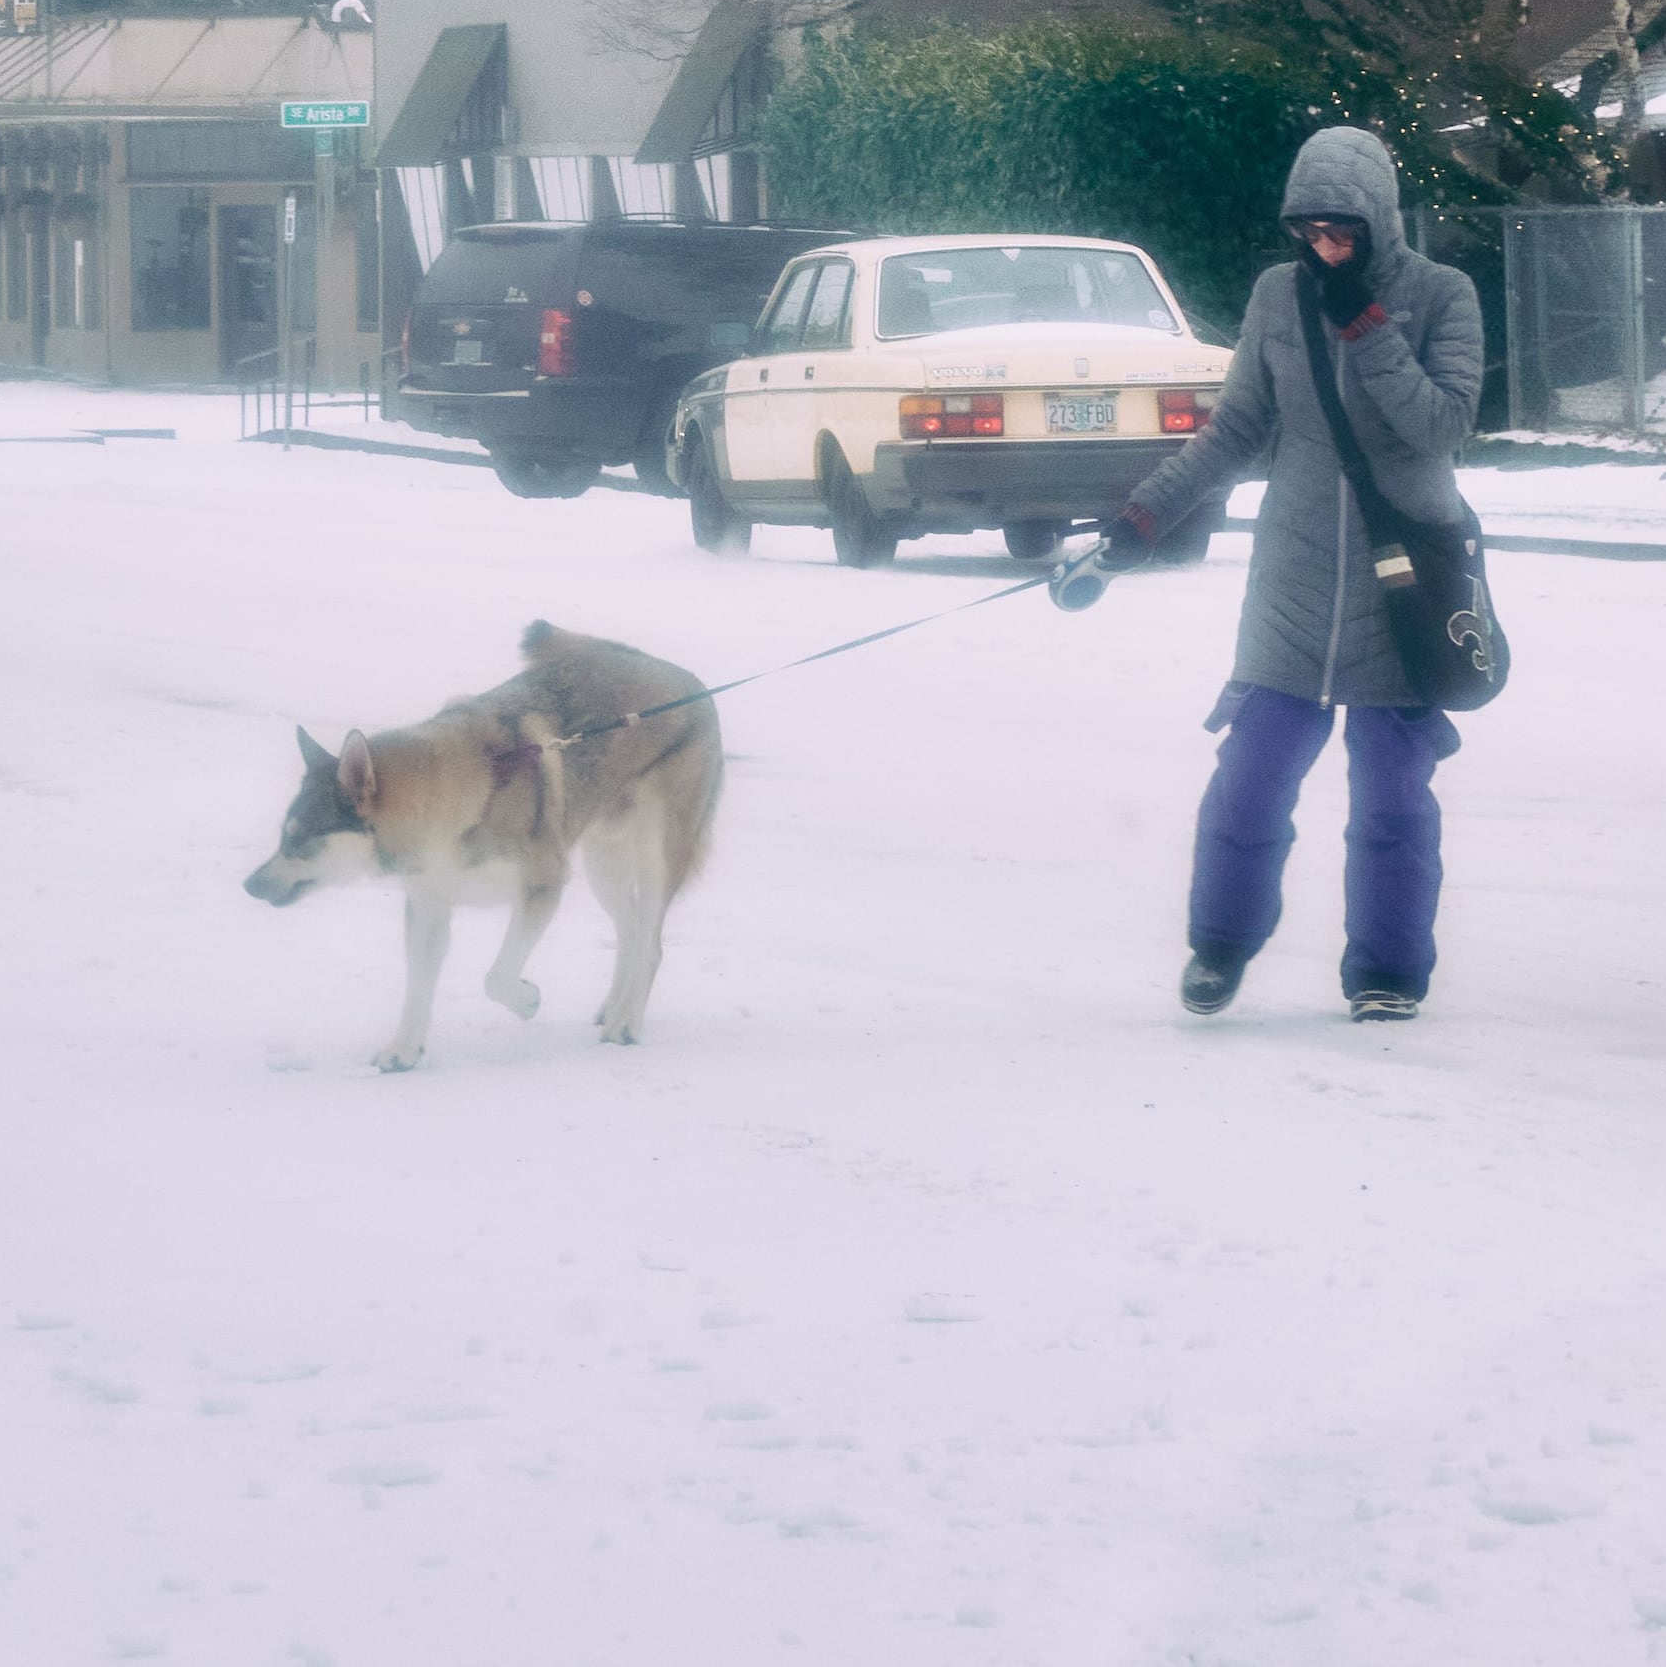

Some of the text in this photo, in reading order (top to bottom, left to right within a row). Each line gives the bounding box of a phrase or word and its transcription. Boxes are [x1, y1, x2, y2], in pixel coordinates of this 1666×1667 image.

[291, 107, 304, 118] SE
[306, 106, 345, 121] Arista
[932, 366, 983, 379] VOLVO
[1049, 404, 1077, 425] 273
